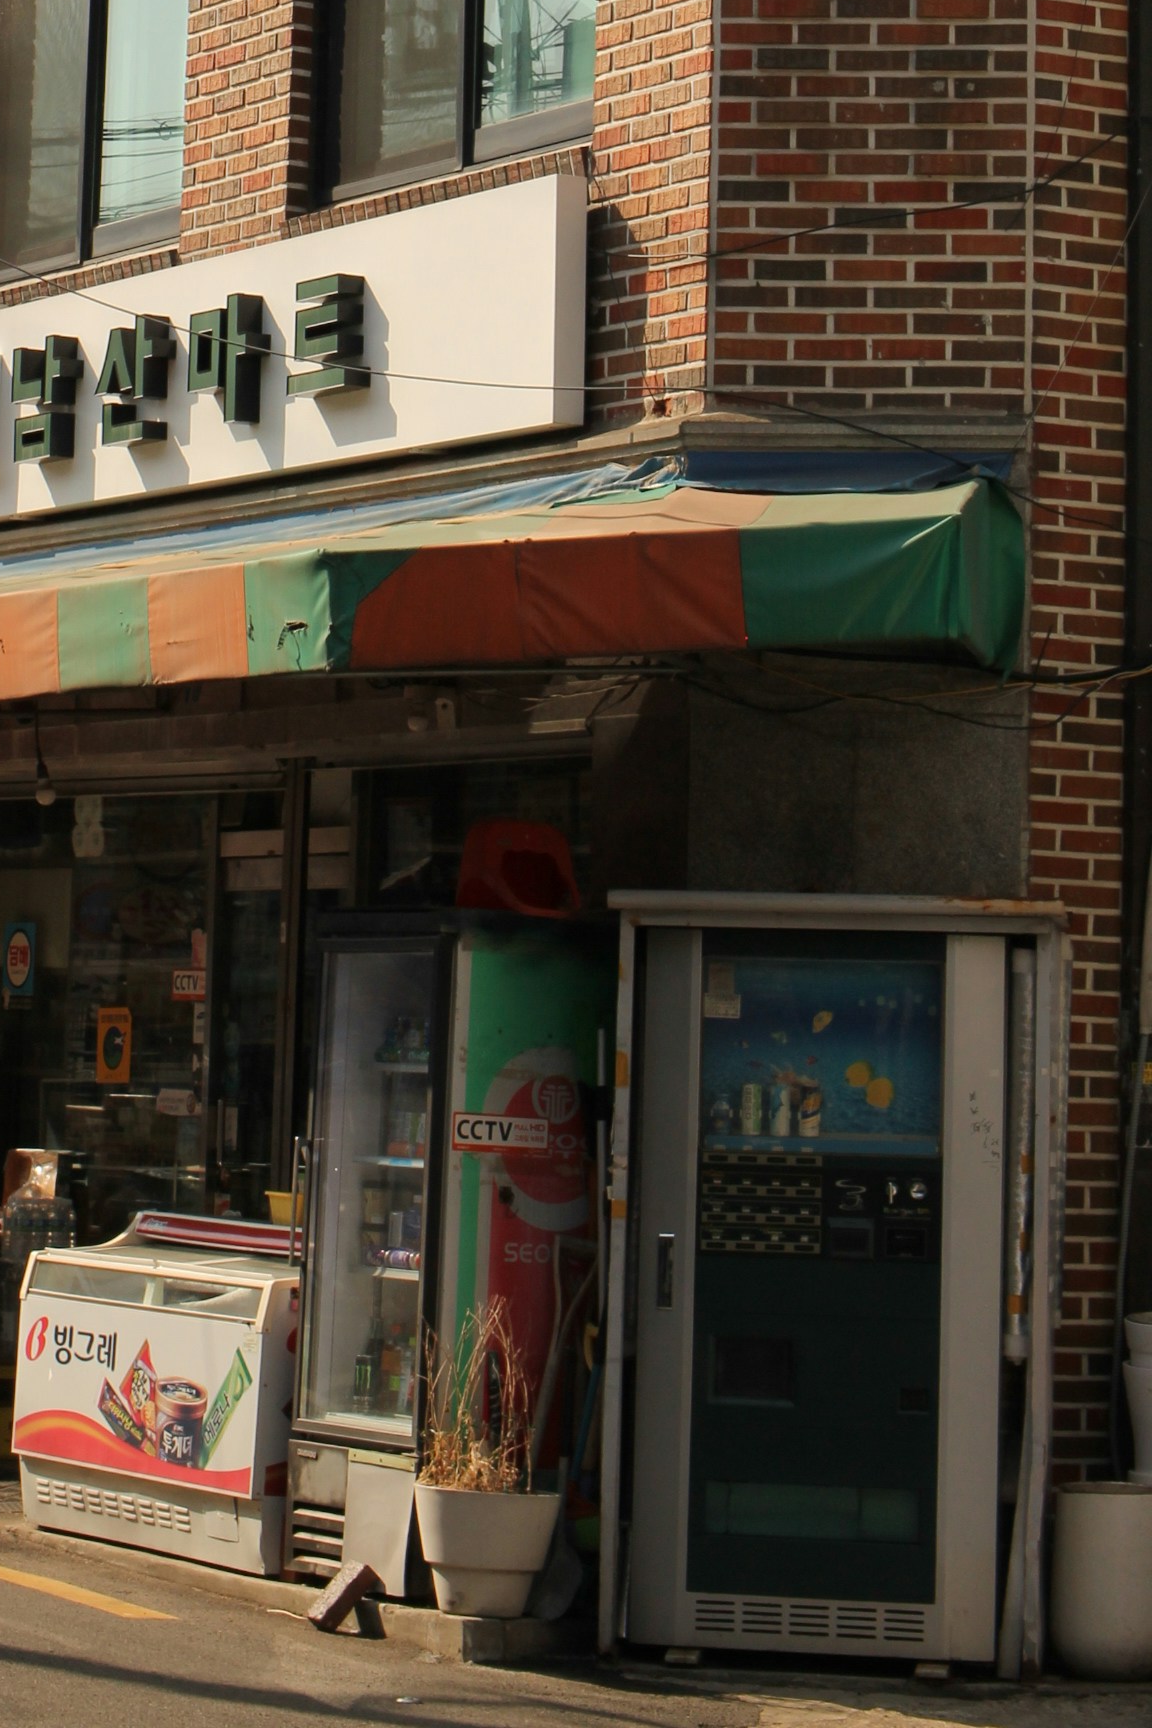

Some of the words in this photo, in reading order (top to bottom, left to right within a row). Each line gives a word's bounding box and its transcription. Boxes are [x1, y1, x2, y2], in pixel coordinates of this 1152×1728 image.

[11, 273, 371, 465] 남산마트
[174, 974, 199, 991] CCTV
[457, 1119, 513, 1142] CCTV
[530, 1123, 546, 1132] HD
[503, 1241, 551, 1264] SEO
[53, 1324, 119, 1372] 빙그레
[203, 1392, 231, 1446] 메로나
[162, 1430, 193, 1459] 투게더
